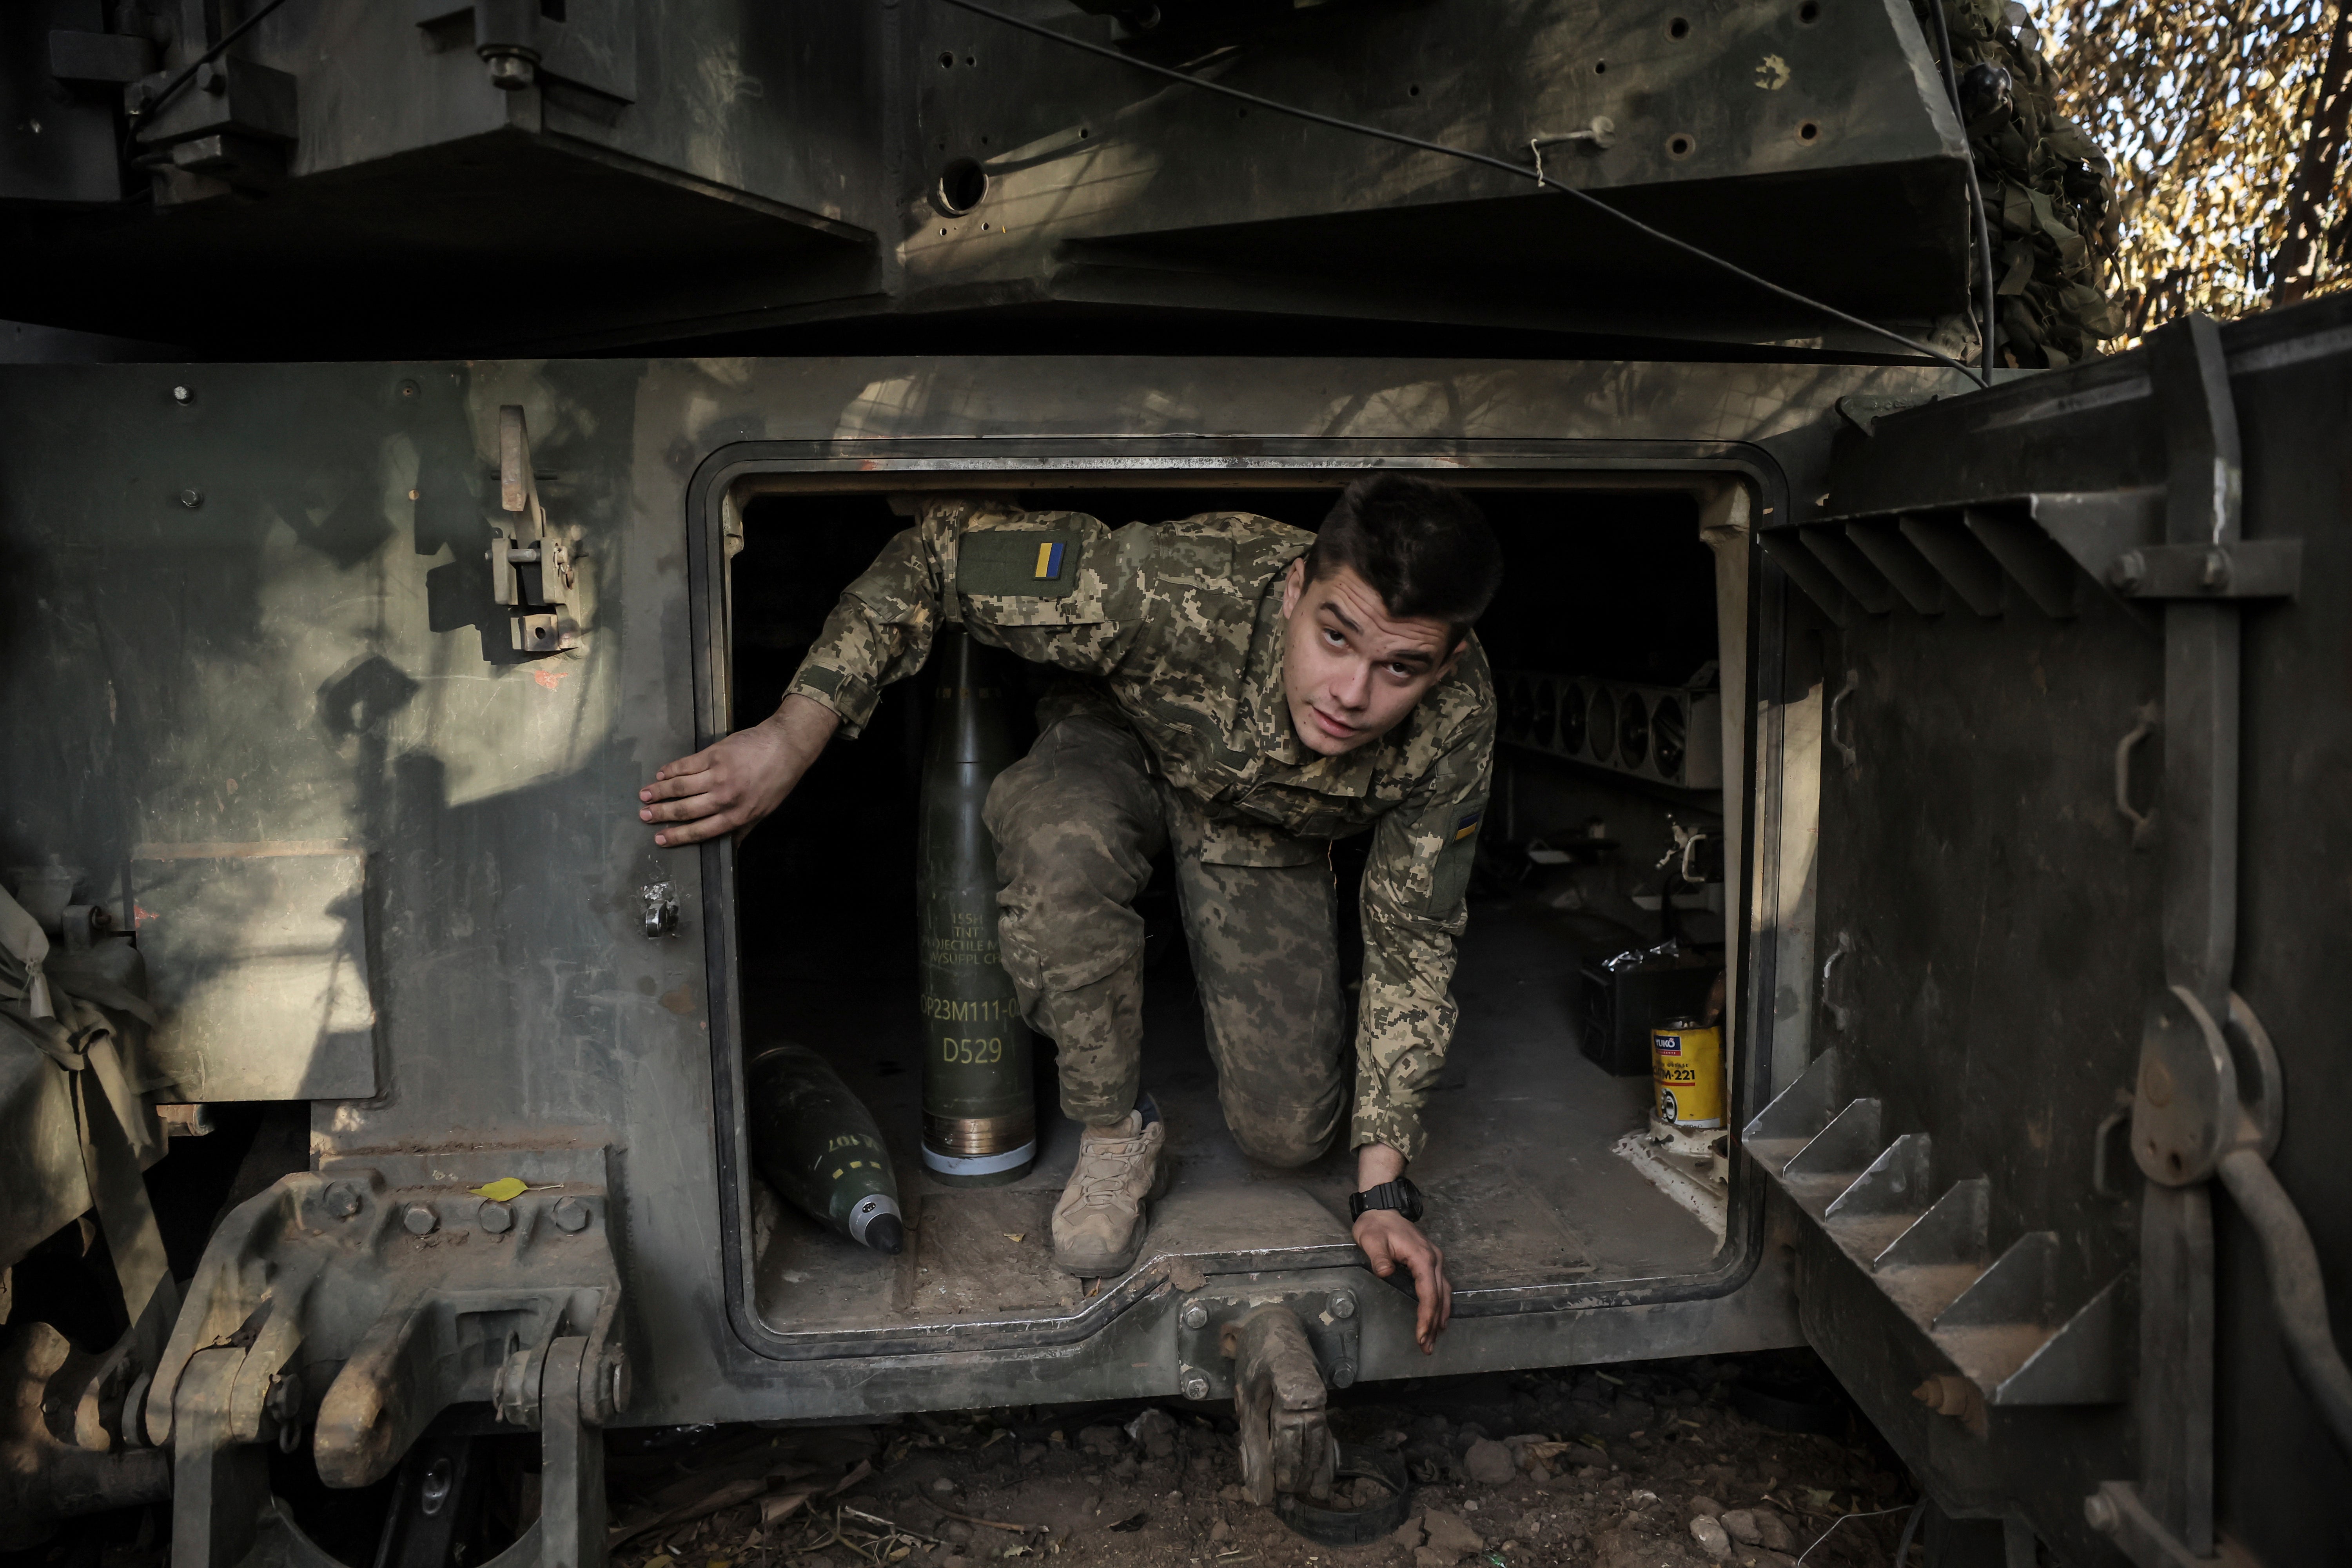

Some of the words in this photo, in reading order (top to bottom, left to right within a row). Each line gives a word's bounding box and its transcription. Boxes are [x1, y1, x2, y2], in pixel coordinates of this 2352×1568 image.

[920, 994, 1021, 1021] OP23M111-0
[943, 1037, 1002, 1064] D529
[1655, 1038, 1675, 1048] YUKO
